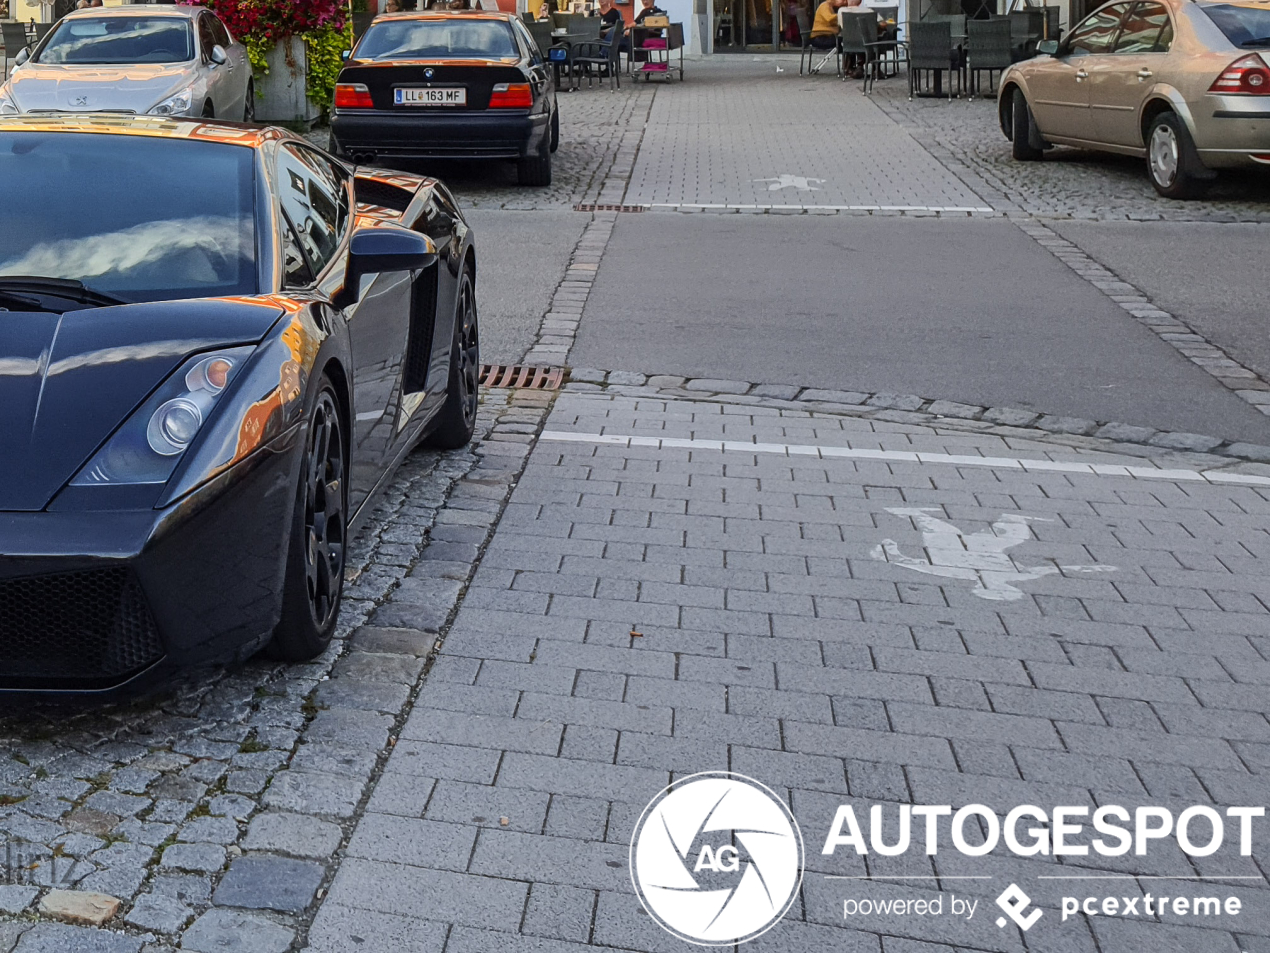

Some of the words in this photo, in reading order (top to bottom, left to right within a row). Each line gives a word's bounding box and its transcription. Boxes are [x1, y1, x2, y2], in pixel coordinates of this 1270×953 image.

[405, 90, 417, 102] LL
[425, 90, 444, 102] 163
[446, 90, 460, 102] MF
